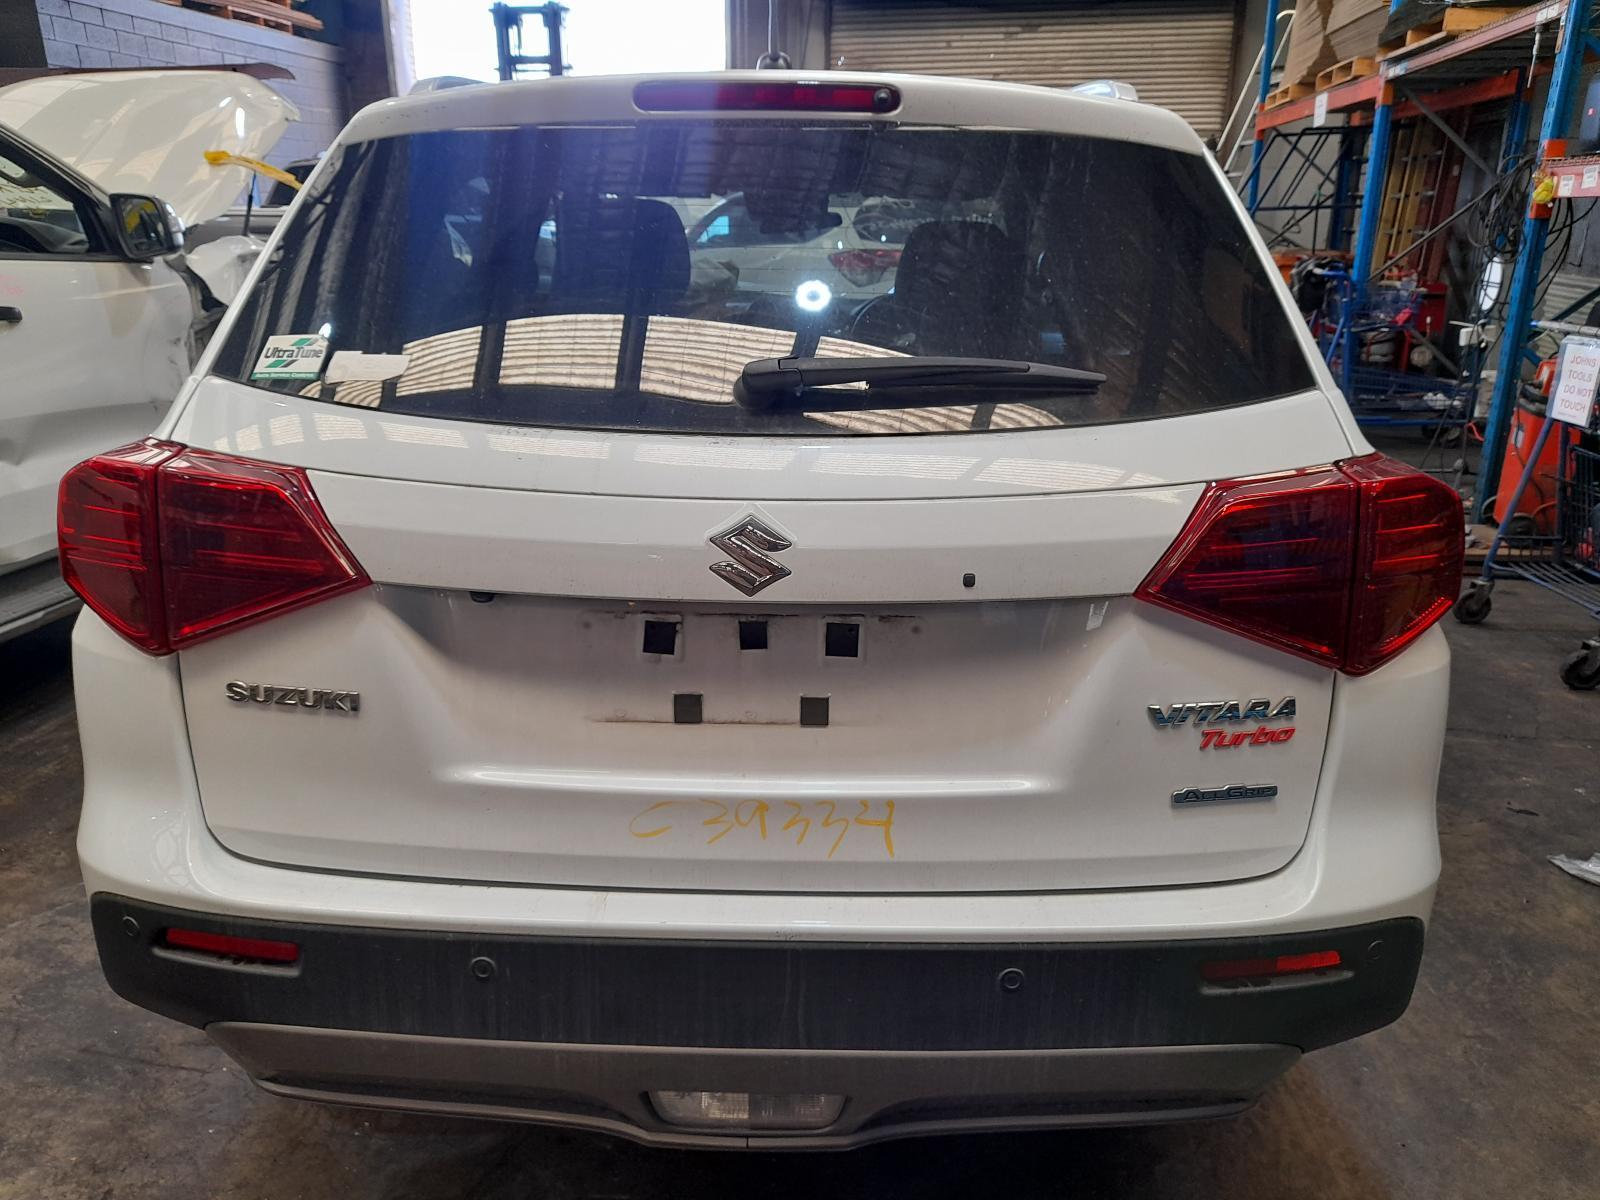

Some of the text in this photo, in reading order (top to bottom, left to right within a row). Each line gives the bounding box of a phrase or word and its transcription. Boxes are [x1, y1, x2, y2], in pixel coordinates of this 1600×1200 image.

[1563, 384, 1576, 394] DO
[1560, 398, 1586, 412] TOUCH
[225, 680, 360, 712] SUZUKI
[1147, 696, 1297, 727] VITARA
[1200, 725, 1296, 750] Turbo
